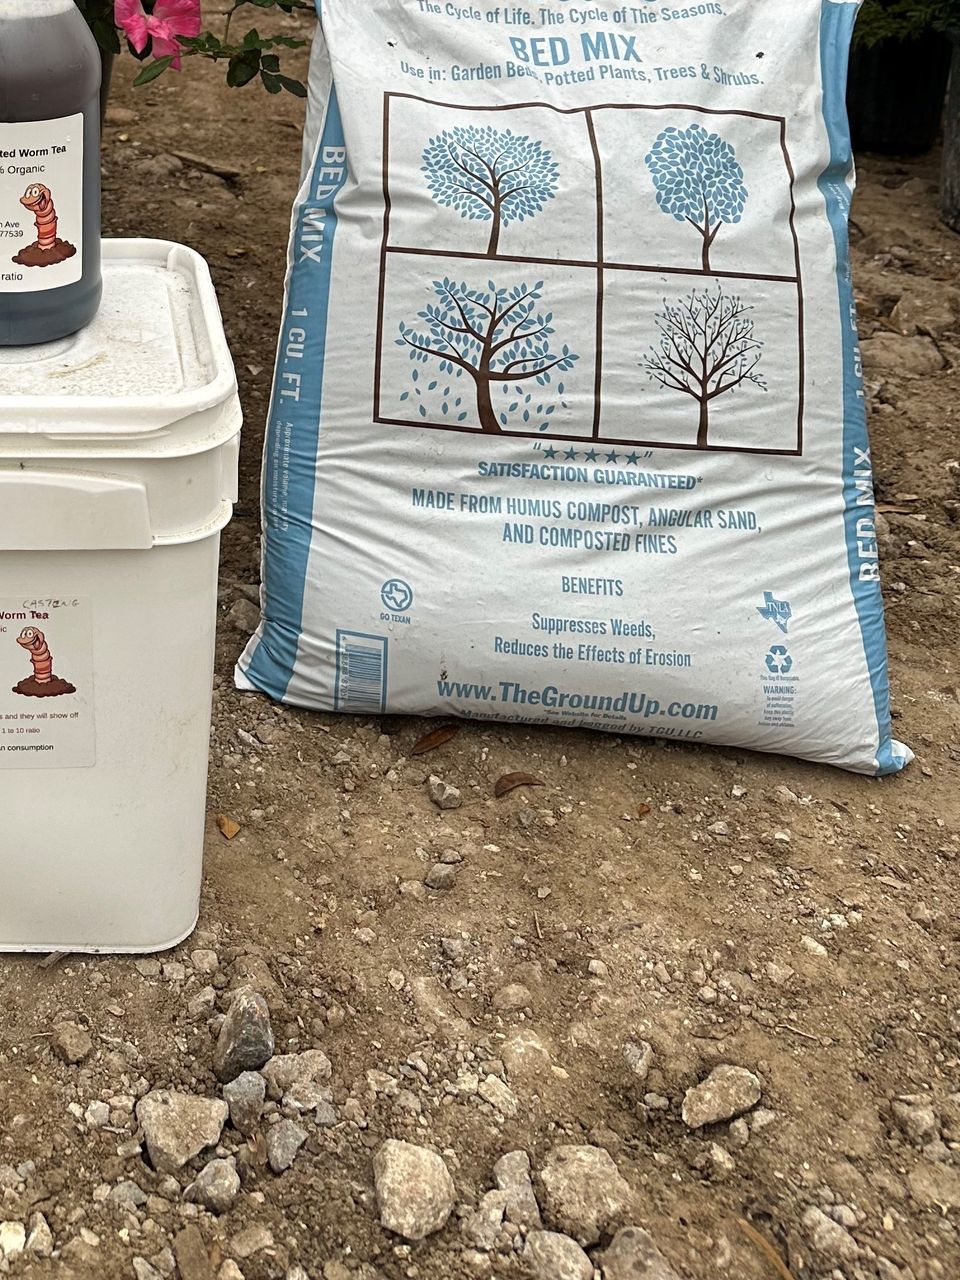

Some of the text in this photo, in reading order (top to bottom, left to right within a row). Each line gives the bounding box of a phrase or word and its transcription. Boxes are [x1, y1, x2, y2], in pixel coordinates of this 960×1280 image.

[445, 2, 482, 20] Cycle
[486, 7, 499, 24] of
[504, 8, 535, 25] Life.
[539, 8, 565, 25] The
[569, 8, 608, 24] Cycle
[613, 6, 627, 24] of
[630, 7, 657, 24] The
[660, 2, 727, 21] Seasons.
[509, 31, 643, 67] BED MIX
[400, 60, 424, 78] Use
[429, 66, 446, 81] in:
[451, 63, 502, 81] Garden
[545, 67, 595, 86] Potted
[598, 64, 652, 83] Plants,
[654, 65, 697, 81] Trees
[700, 63, 710, 80] &
[714, 66, 765, 86] Shrubs.
[19, 147, 49, 157] Worm
[51, 145, 67, 154] Tea
[7, 164, 45, 175] Organic
[299, 146, 346, 263] BED MIX
[0, 230, 24, 238] 77539
[2, 272, 23, 281] ratio
[280, 307, 308, 404] 1 CU. FT.
[478, 461, 588, 483] SATISFACTION
[412, 488, 762, 533] MADE FROM HUMUS COMPOST, ANGULAR SAND,
[853, 446, 880, 581] BED MIX
[502, 522, 678, 554] AND COMPOSTED FINES
[561, 576, 624, 597] BENEFITS
[29, 610, 49, 620] Tea
[380, 612, 411, 624] GO TEXAN
[532, 612, 656, 640] Suppresses Weeds,
[494, 636, 691, 667] Reduces the Effects of Erosion
[437, 680, 718, 720] www.TheGroundUp.com
[763, 685, 797, 695] WARNING:
[19, 713, 35, 721] they
[7, 744, 54, 752] consumption
